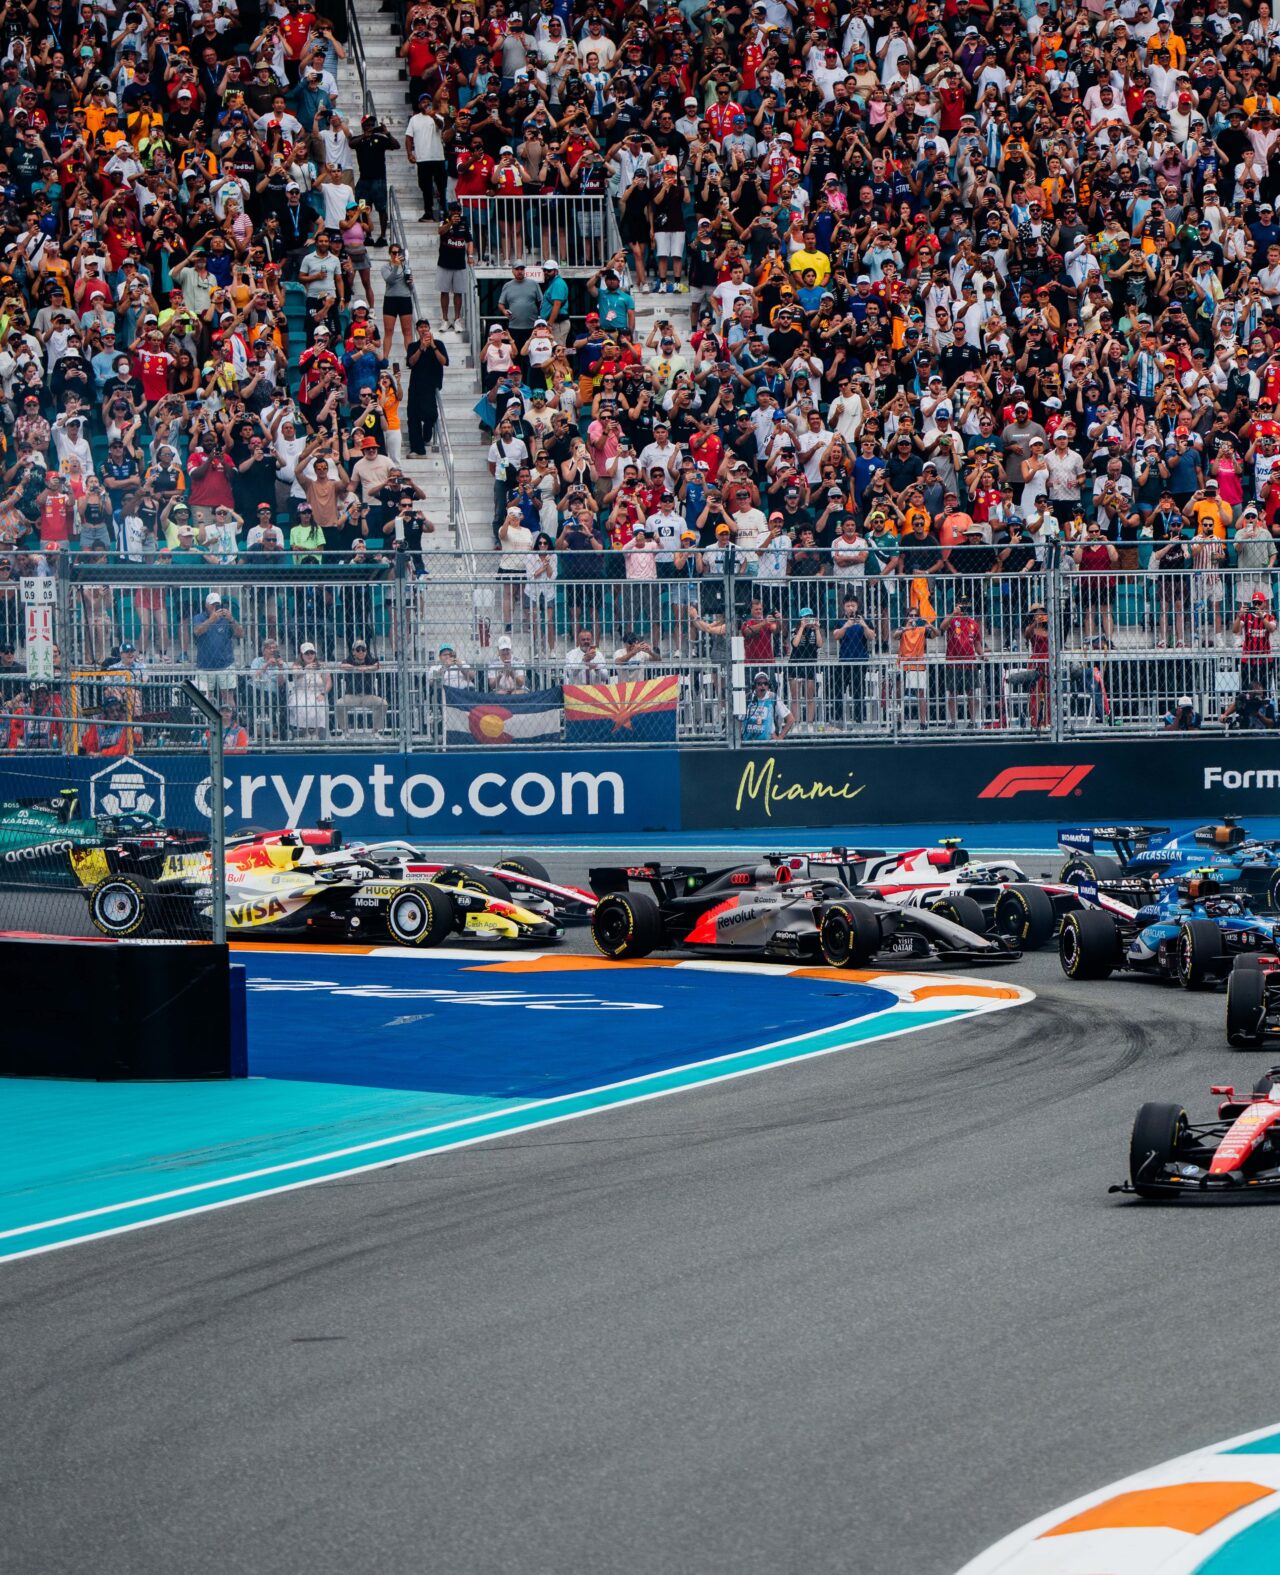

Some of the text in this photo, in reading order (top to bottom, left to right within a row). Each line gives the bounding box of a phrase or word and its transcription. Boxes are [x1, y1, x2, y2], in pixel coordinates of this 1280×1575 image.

[24, 580, 35, 589] MP
[43, 580, 52, 589] MP
[24, 591, 35, 600] 0.9
[43, 591, 53, 600] 0.9
[735, 757, 866, 816] Miami
[977, 764, 1095, 799] F1
[194, 764, 624, 828] crypto.com
[1061, 833, 1090, 843] KOMATSU
[6, 841, 73, 862] aramco
[1136, 851, 1183, 861] ATLASSIAN
[169, 856, 184, 872] 41
[227, 873, 246, 883] Bull
[356, 870, 370, 879] FIX
[1193, 872, 1224, 881] BALAYS
[365, 886, 396, 895] HUGO
[355, 897, 379, 907] Mobil
[458, 897, 471, 905] FIA
[229, 895, 287, 925] VISA
[717, 909, 756, 930] Revolut
[466, 920, 498, 930] Cash App
[892, 943, 913, 952] QATAR
